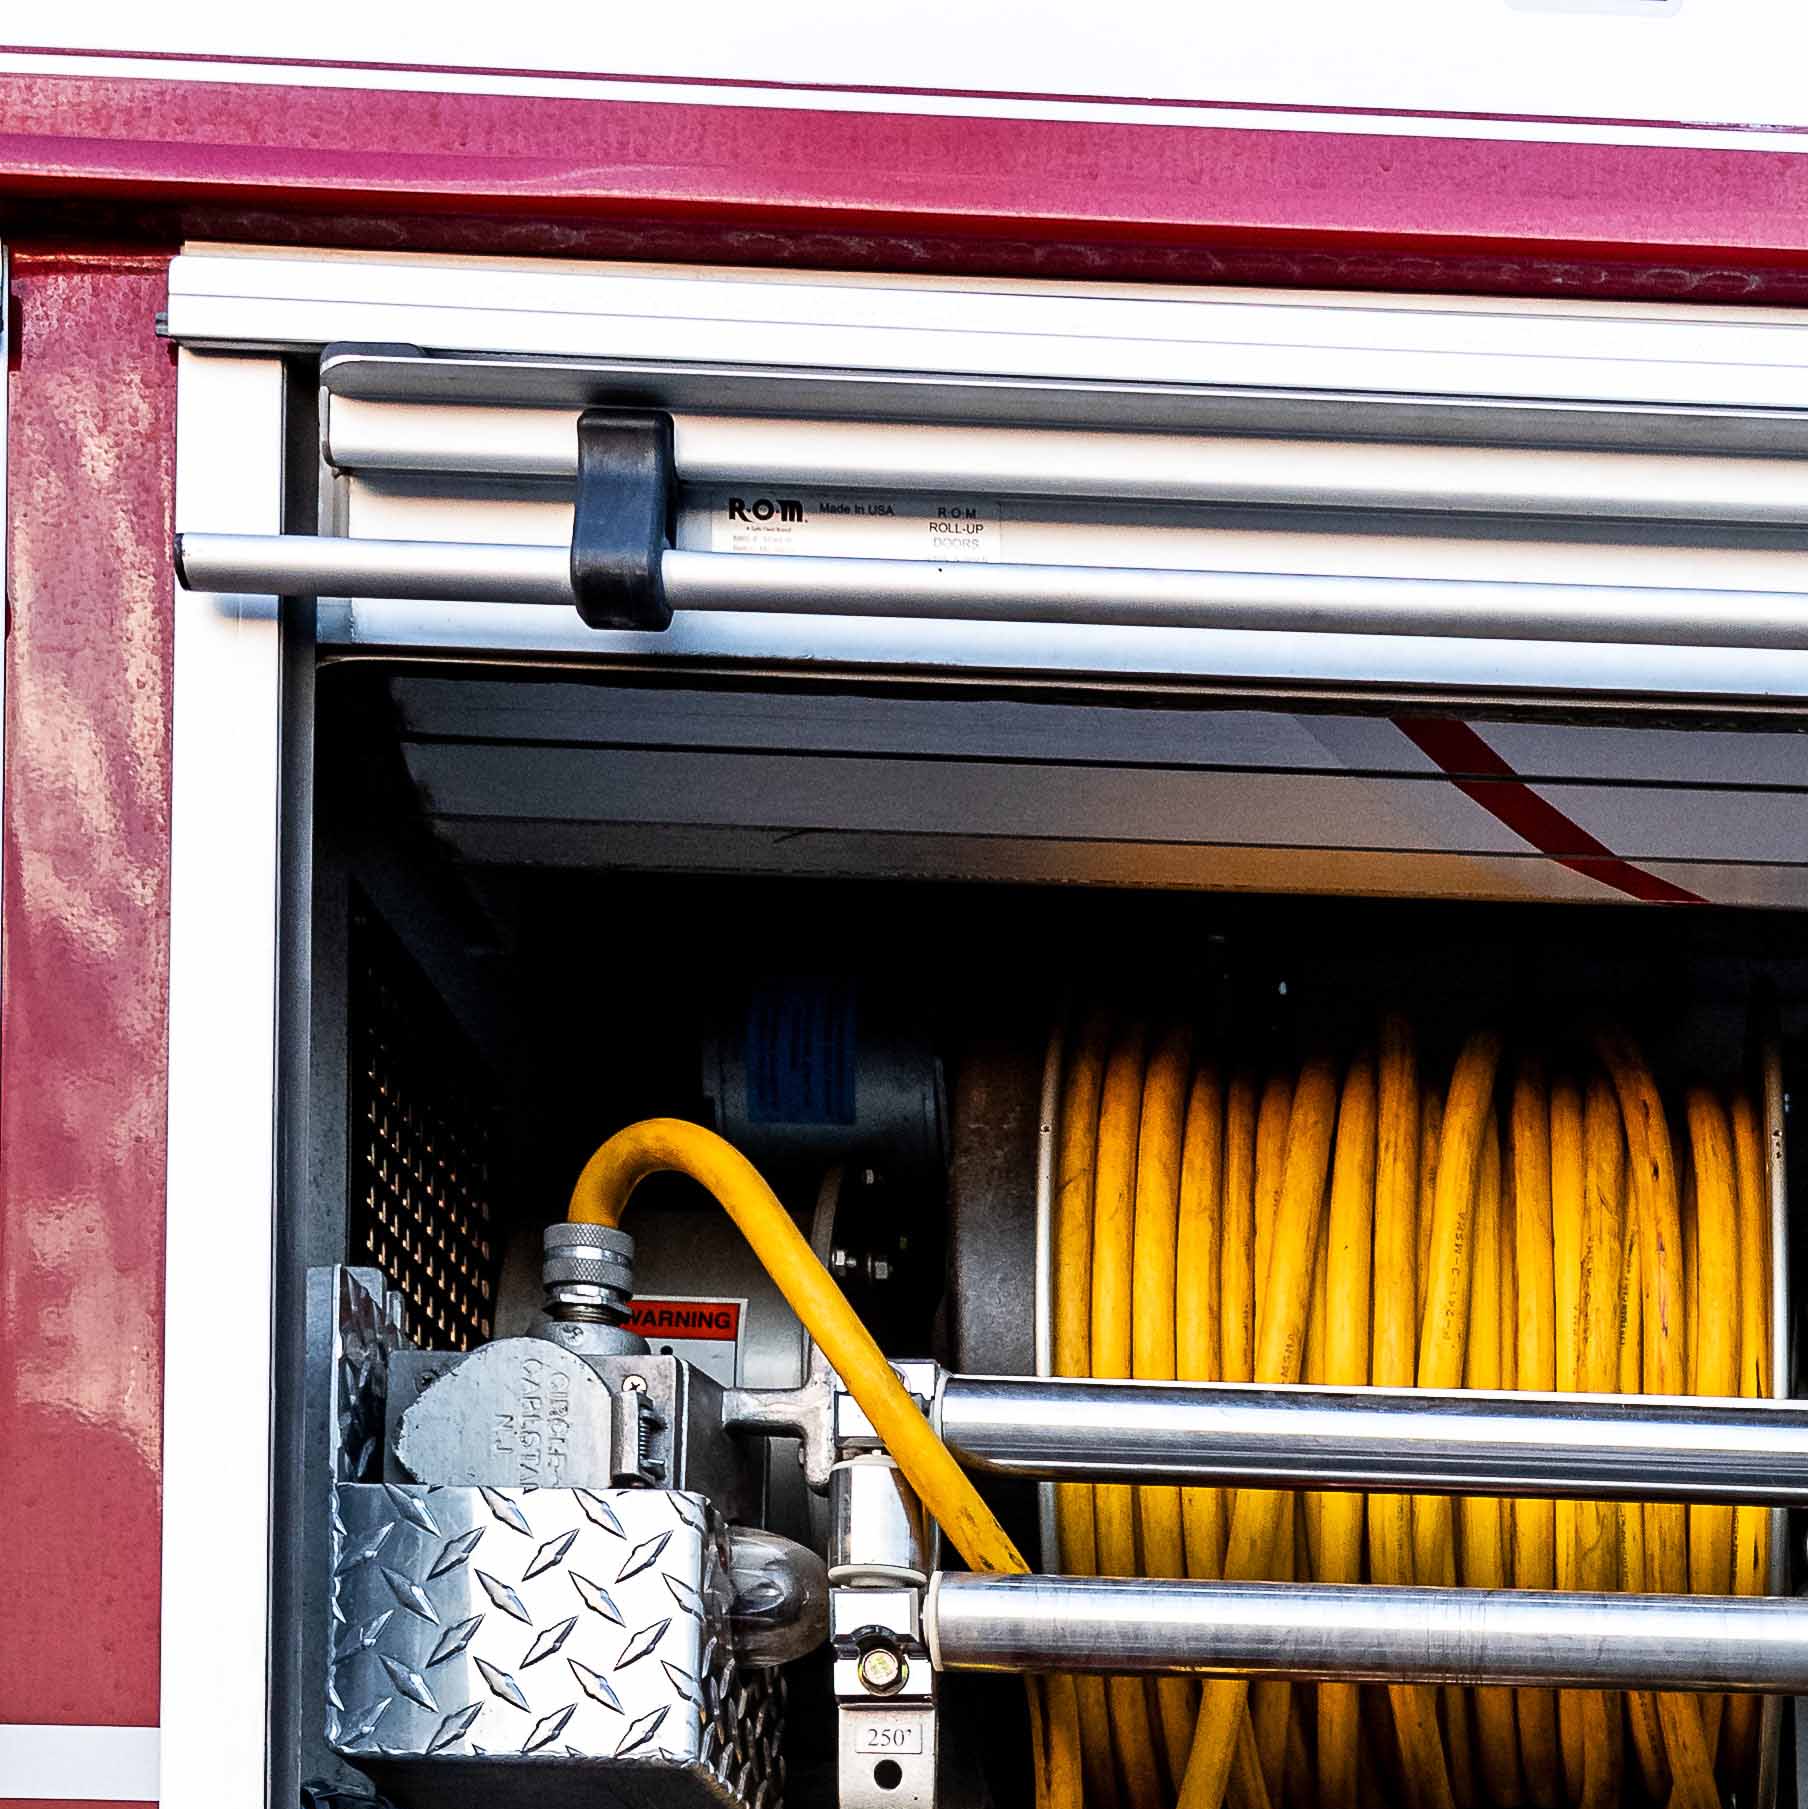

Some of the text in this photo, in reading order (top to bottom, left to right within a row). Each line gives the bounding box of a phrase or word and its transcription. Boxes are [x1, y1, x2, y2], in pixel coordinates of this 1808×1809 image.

[819, 503, 851, 515] Made
[870, 505, 895, 517] USA
[929, 522, 984, 535] ROLL-UP
